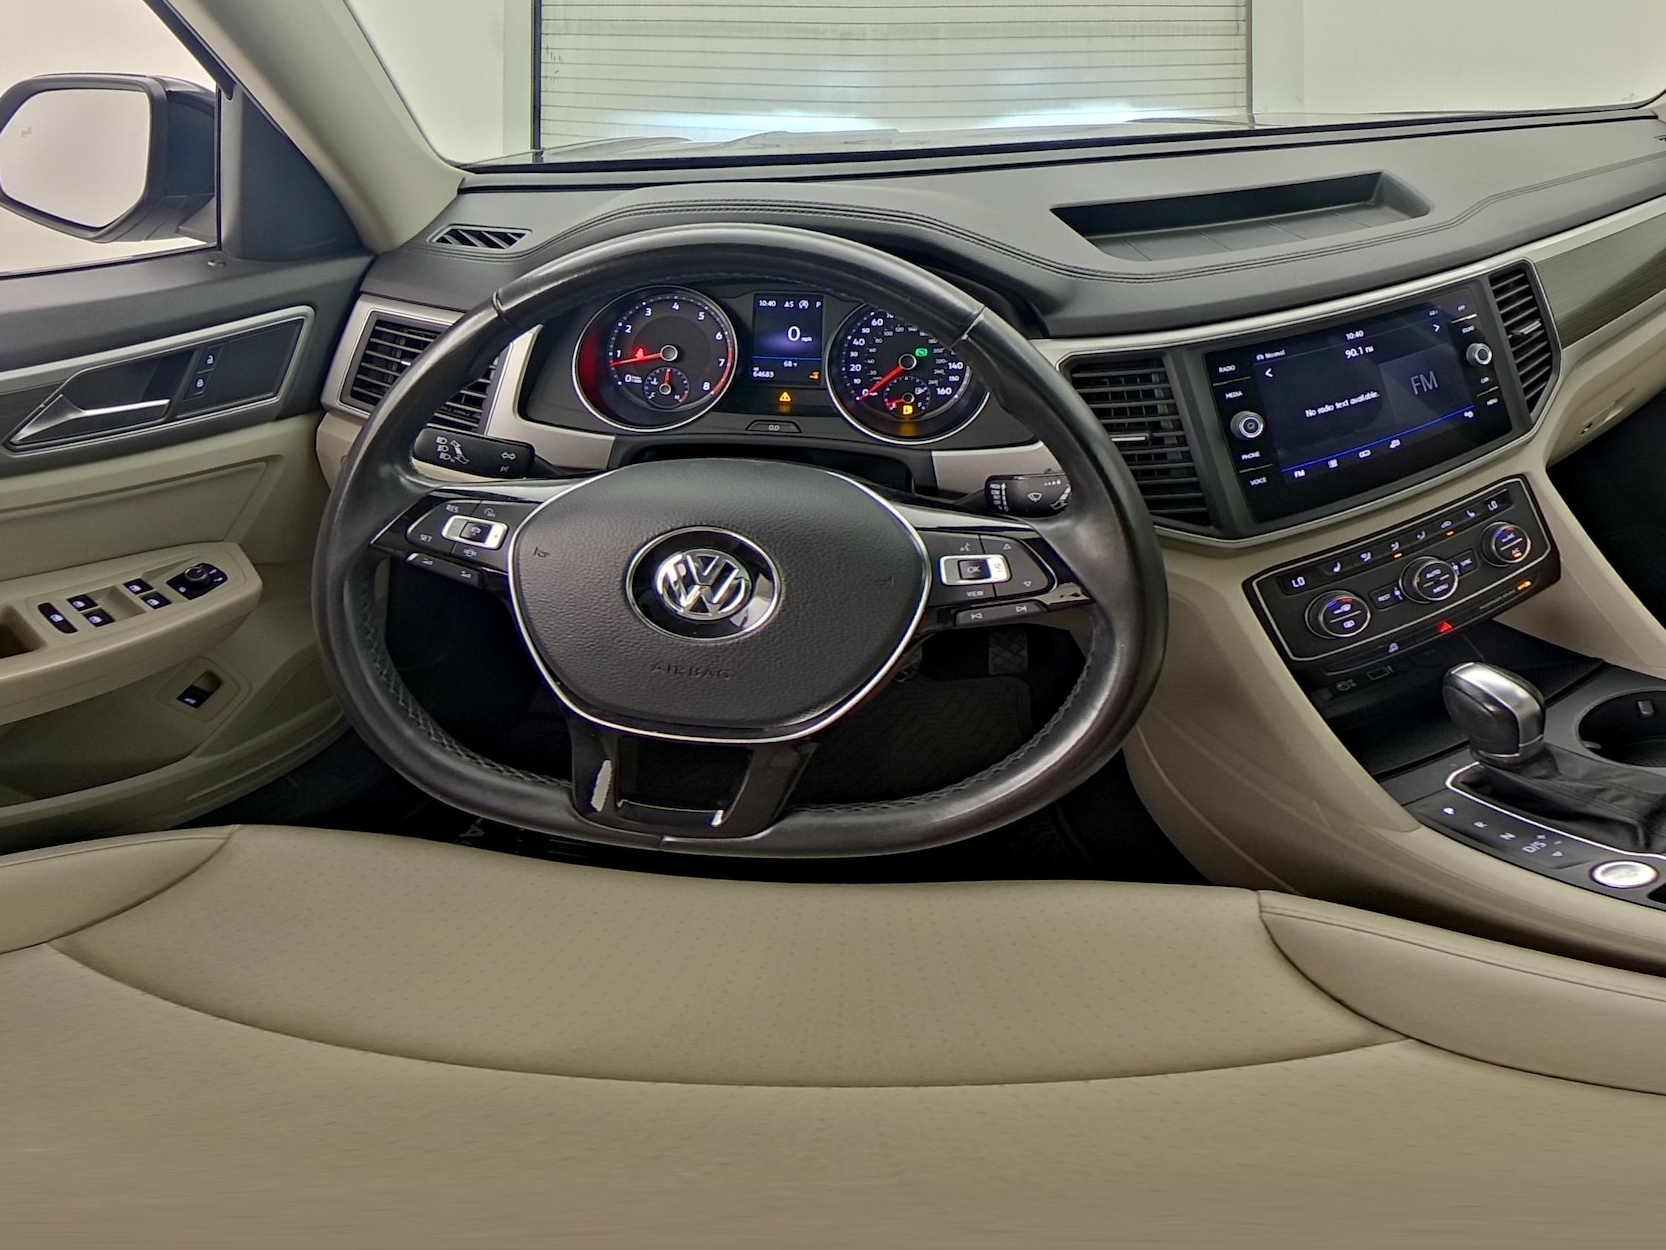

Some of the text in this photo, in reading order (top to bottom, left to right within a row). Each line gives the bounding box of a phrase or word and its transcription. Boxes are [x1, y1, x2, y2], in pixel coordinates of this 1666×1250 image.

[672, 302, 680, 311] 4
[759, 299, 777, 308] 10:40
[644, 307, 652, 317] 3
[698, 311, 705, 321] 5
[871, 318, 884, 327] 60
[625, 324, 632, 333] 2
[787, 325, 801, 342] 0
[715, 331, 723, 341] 6
[1345, 329, 1364, 341] 10:40
[852, 338, 866, 346] 40
[616, 350, 621, 358] 1
[1345, 346, 1364, 359] 90.1
[718, 358, 726, 367] 7
[849, 363, 862, 372] 20
[947, 361, 964, 370] 140
[1218, 364, 1236, 373] RADIO
[624, 373, 632, 382] 0
[702, 381, 711, 391] 8
[1410, 370, 1439, 396] FM
[936, 387, 953, 395] 160
[1225, 390, 1243, 400] MEDIA
[1305, 408, 1317, 418] No
[1317, 403, 1335, 416] radio
[1335, 398, 1350, 410] text
[1241, 451, 1261, 461] PHONE
[1293, 469, 1306, 479] FM
[1249, 476, 1268, 486] VOICE
[445, 504, 460, 513] RES
[419, 533, 433, 543] SET
[966, 565, 982, 574] OK
[1425, 568, 1442, 579] AUTO
[1432, 583, 1449, 594] MENU
[966, 590, 984, 598] VIEW
[650, 662, 732, 681] AIRBAG
